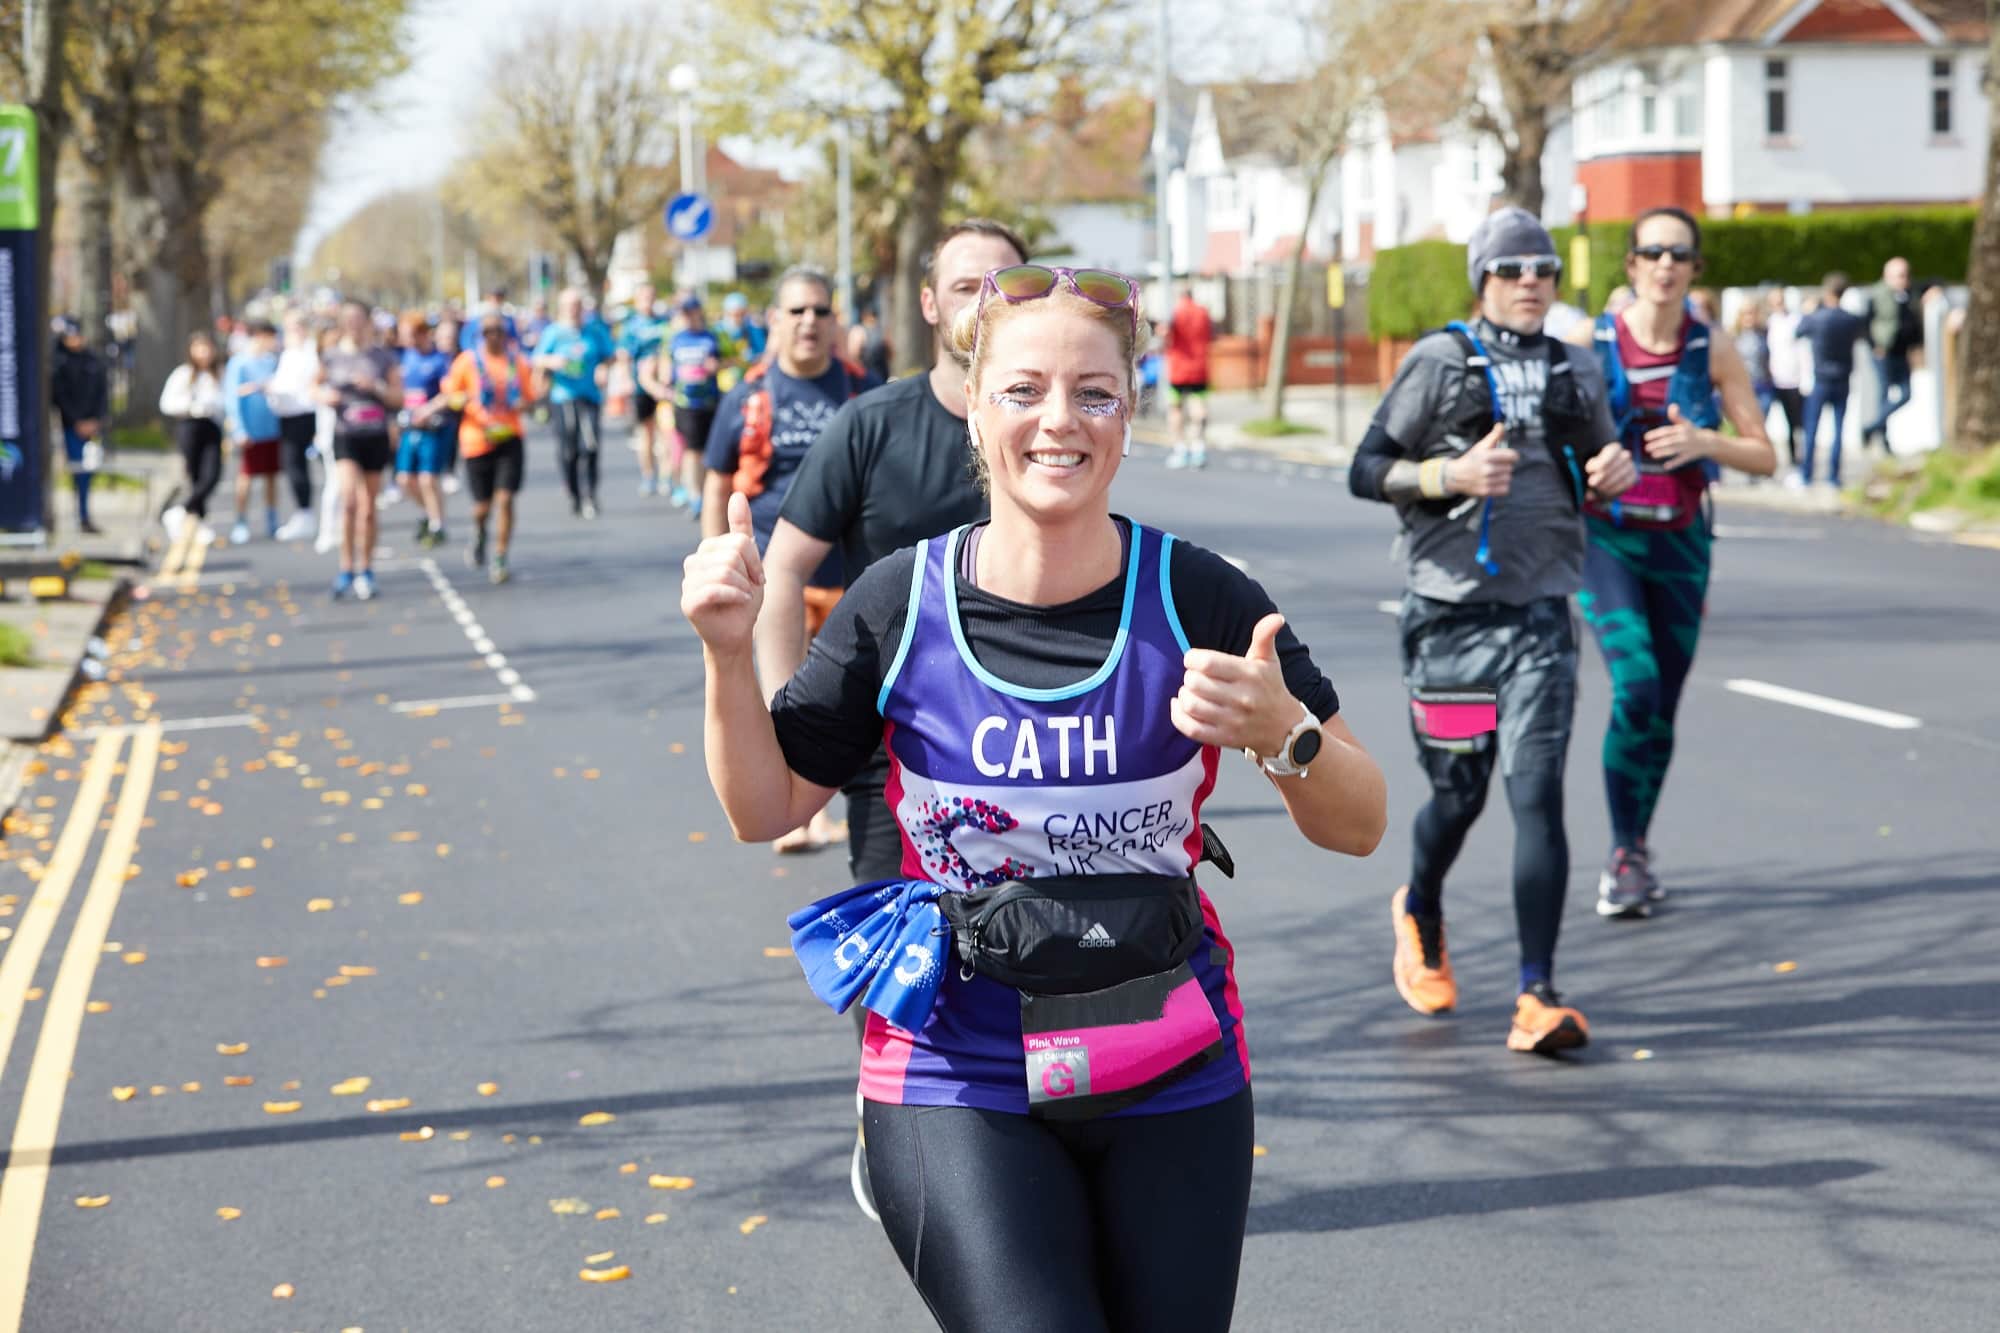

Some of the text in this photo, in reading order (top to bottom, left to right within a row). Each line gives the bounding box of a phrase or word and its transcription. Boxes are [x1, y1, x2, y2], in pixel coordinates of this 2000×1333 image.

[971, 715, 1118, 779] CATH
[1043, 799, 1173, 839] CANCER
[1078, 937, 1116, 948] adidas
[1029, 1036, 1080, 1049] Pink Wave
[1041, 1062, 1076, 1098] G
